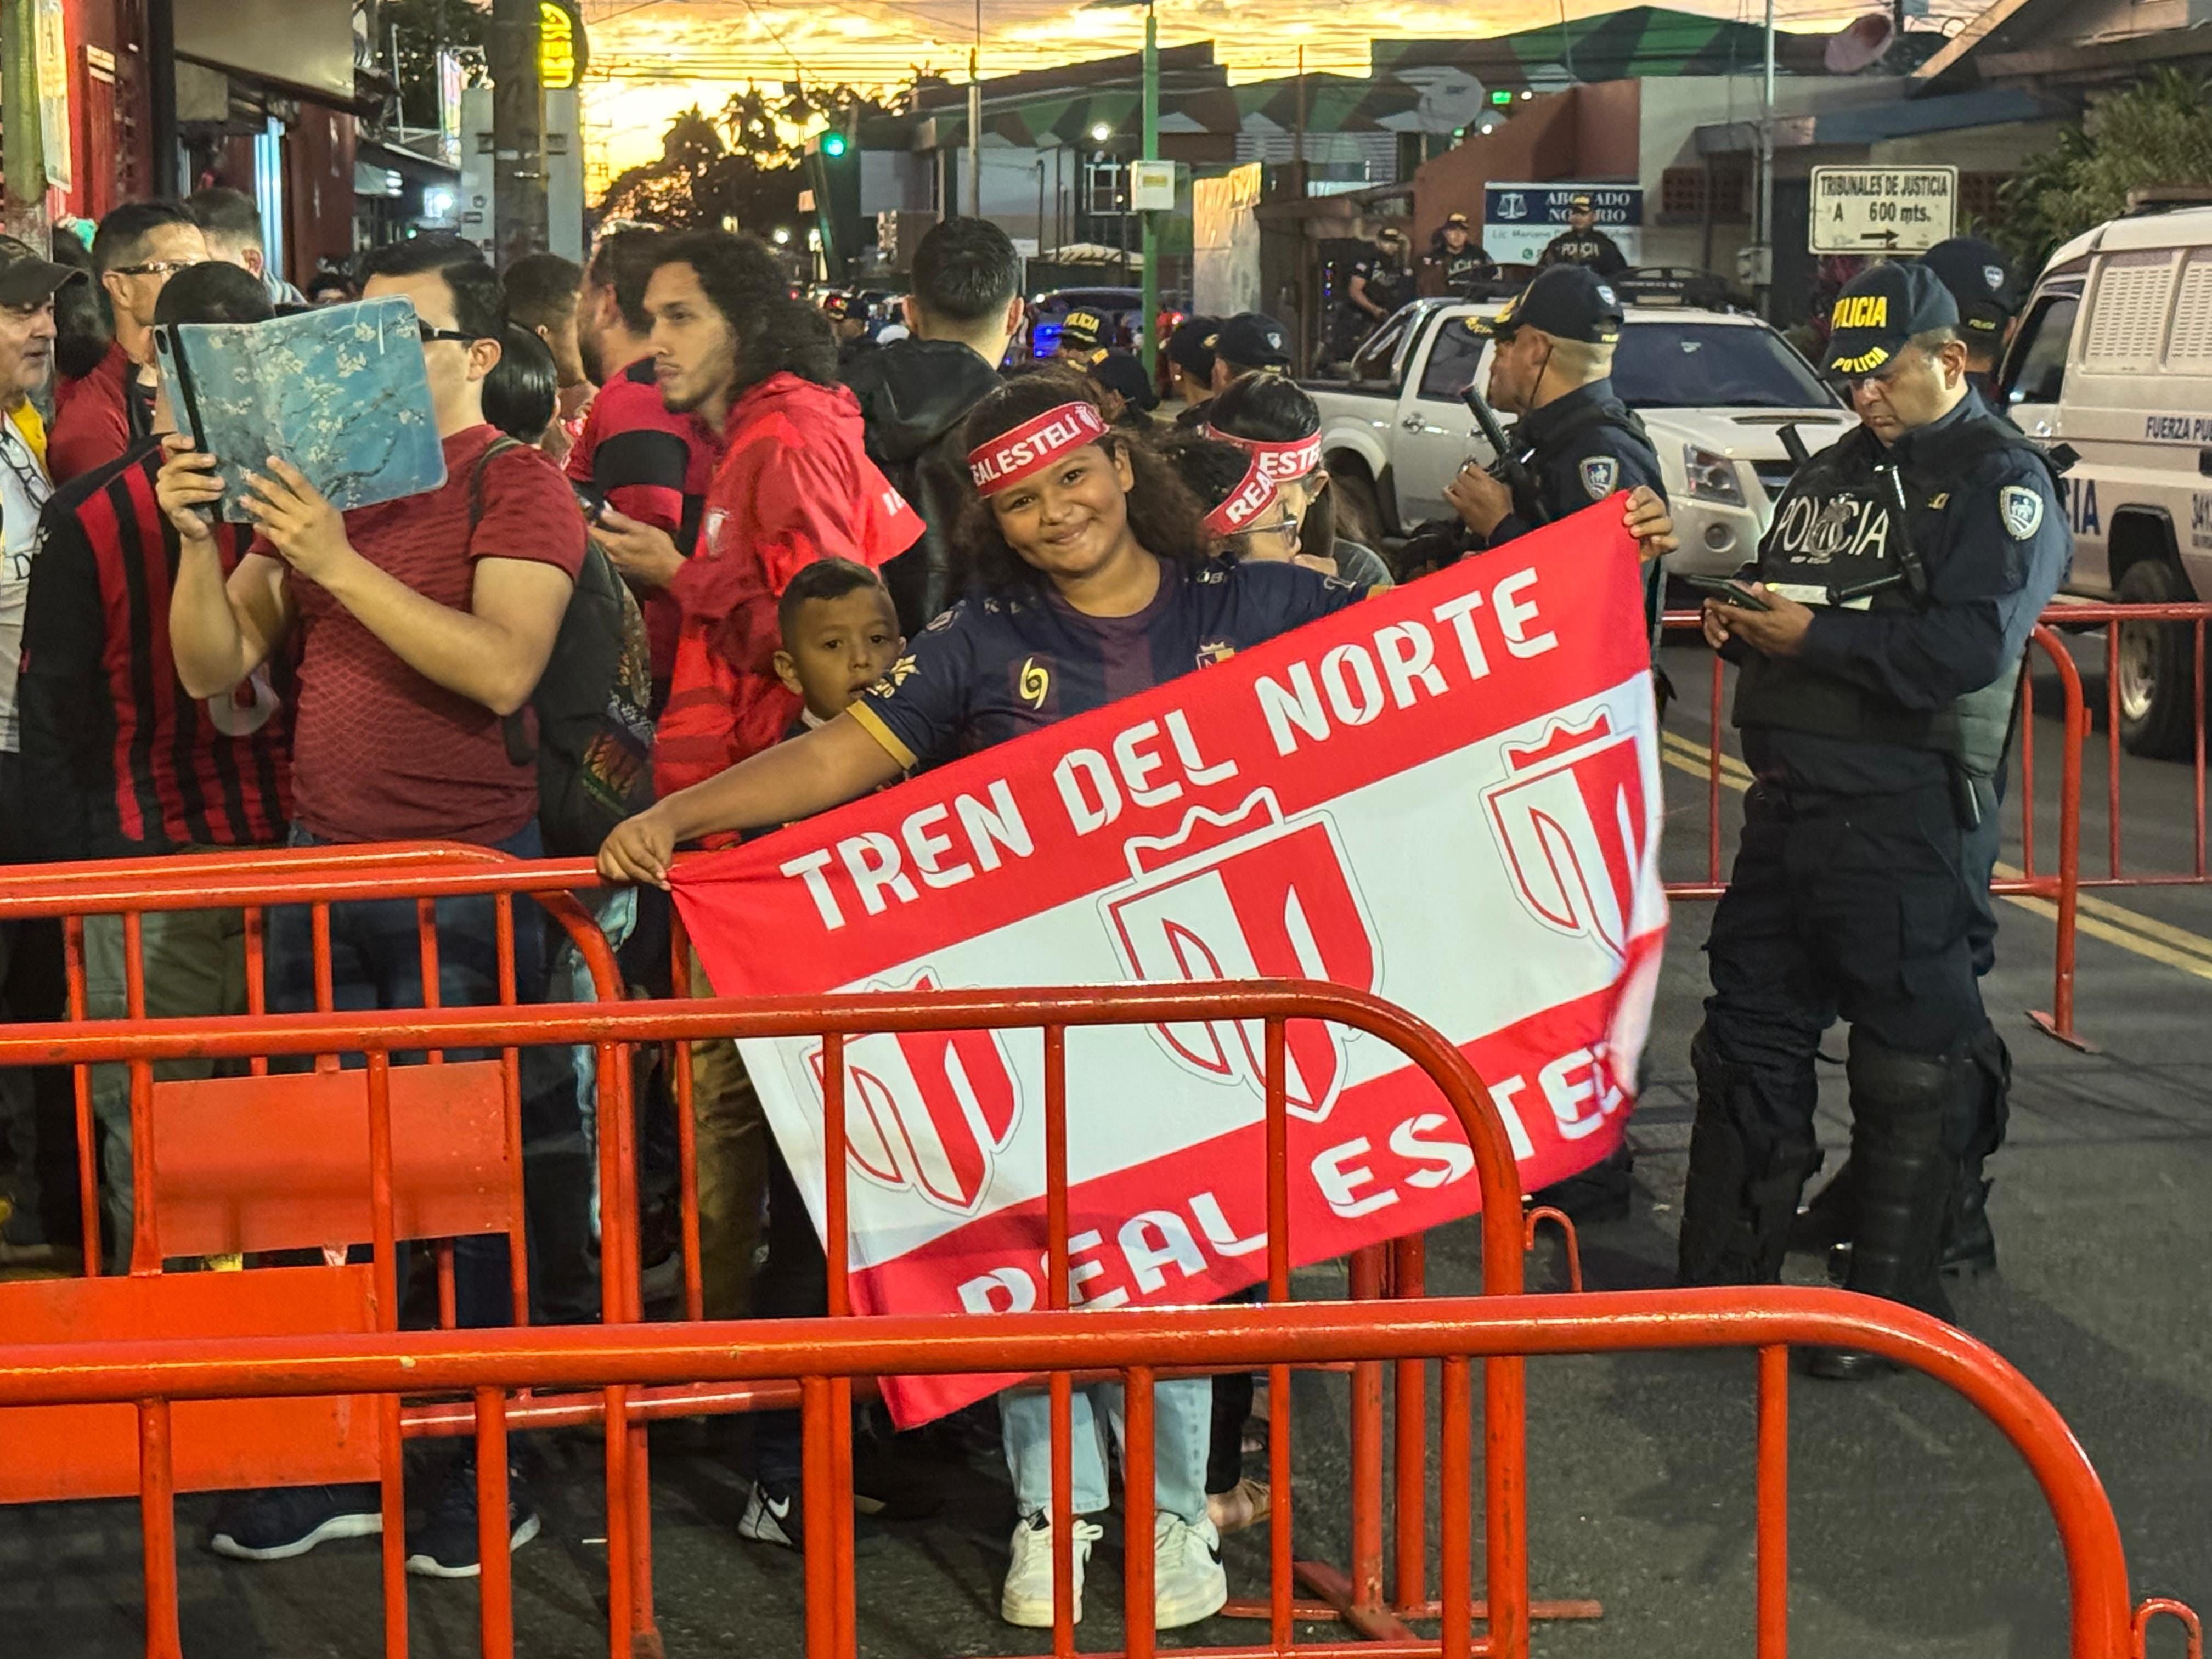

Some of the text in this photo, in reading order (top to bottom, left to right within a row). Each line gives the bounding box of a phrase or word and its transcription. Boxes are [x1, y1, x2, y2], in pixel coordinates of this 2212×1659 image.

[1545, 191, 1631, 205] ABADO
[1821, 175, 1949, 196] TRIBUNALES DE JUSTICIA
[1548, 208, 1627, 222] NORIO
[1833, 201, 1932, 224] A 600 mts.
[1831, 346, 1889, 373] POLICIA
[2146, 416, 2212, 442] FUERZA PU
[969, 458, 1001, 487] EAL
[1225, 439, 1322, 524] REA ESTE
[779, 566, 1559, 932] TREN DEL NORTE
